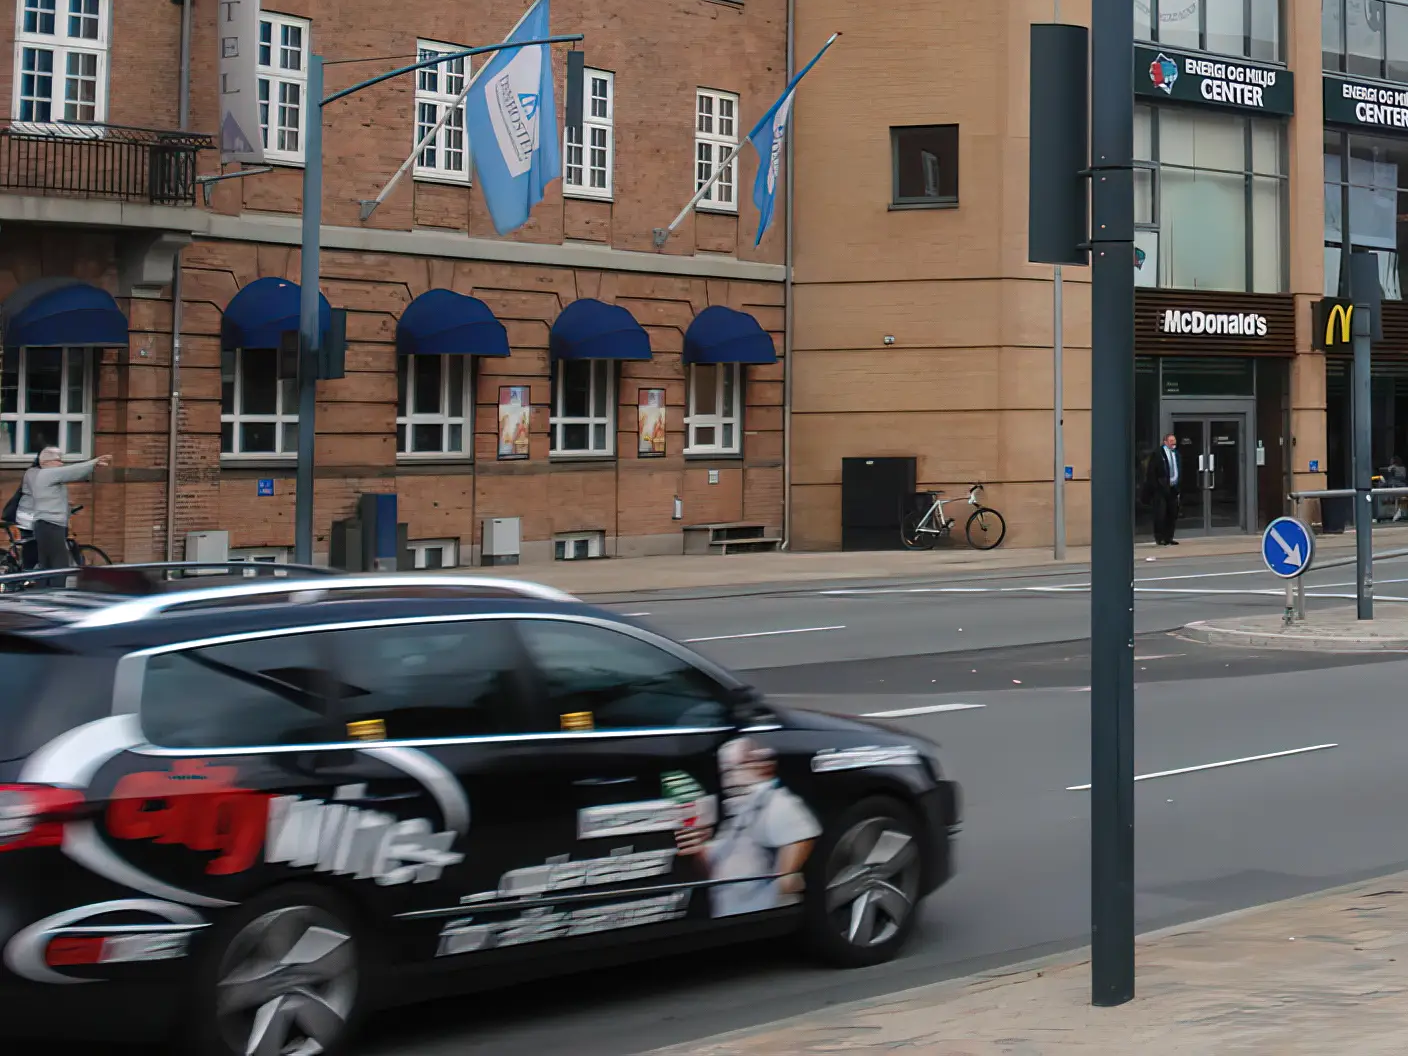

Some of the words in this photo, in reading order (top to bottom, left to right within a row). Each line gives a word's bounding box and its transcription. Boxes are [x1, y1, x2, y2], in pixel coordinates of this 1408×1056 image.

[1185, 58, 1226, 79] ENERGI
[1226, 66, 1245, 82] OG
[1246, 67, 1277, 88] MILJØ
[1200, 78, 1264, 107] CENTER
[1342, 84, 1378, 102] ENERGI
[1378, 90, 1394, 104] OG
[1163, 309, 1268, 336] McDonald's
